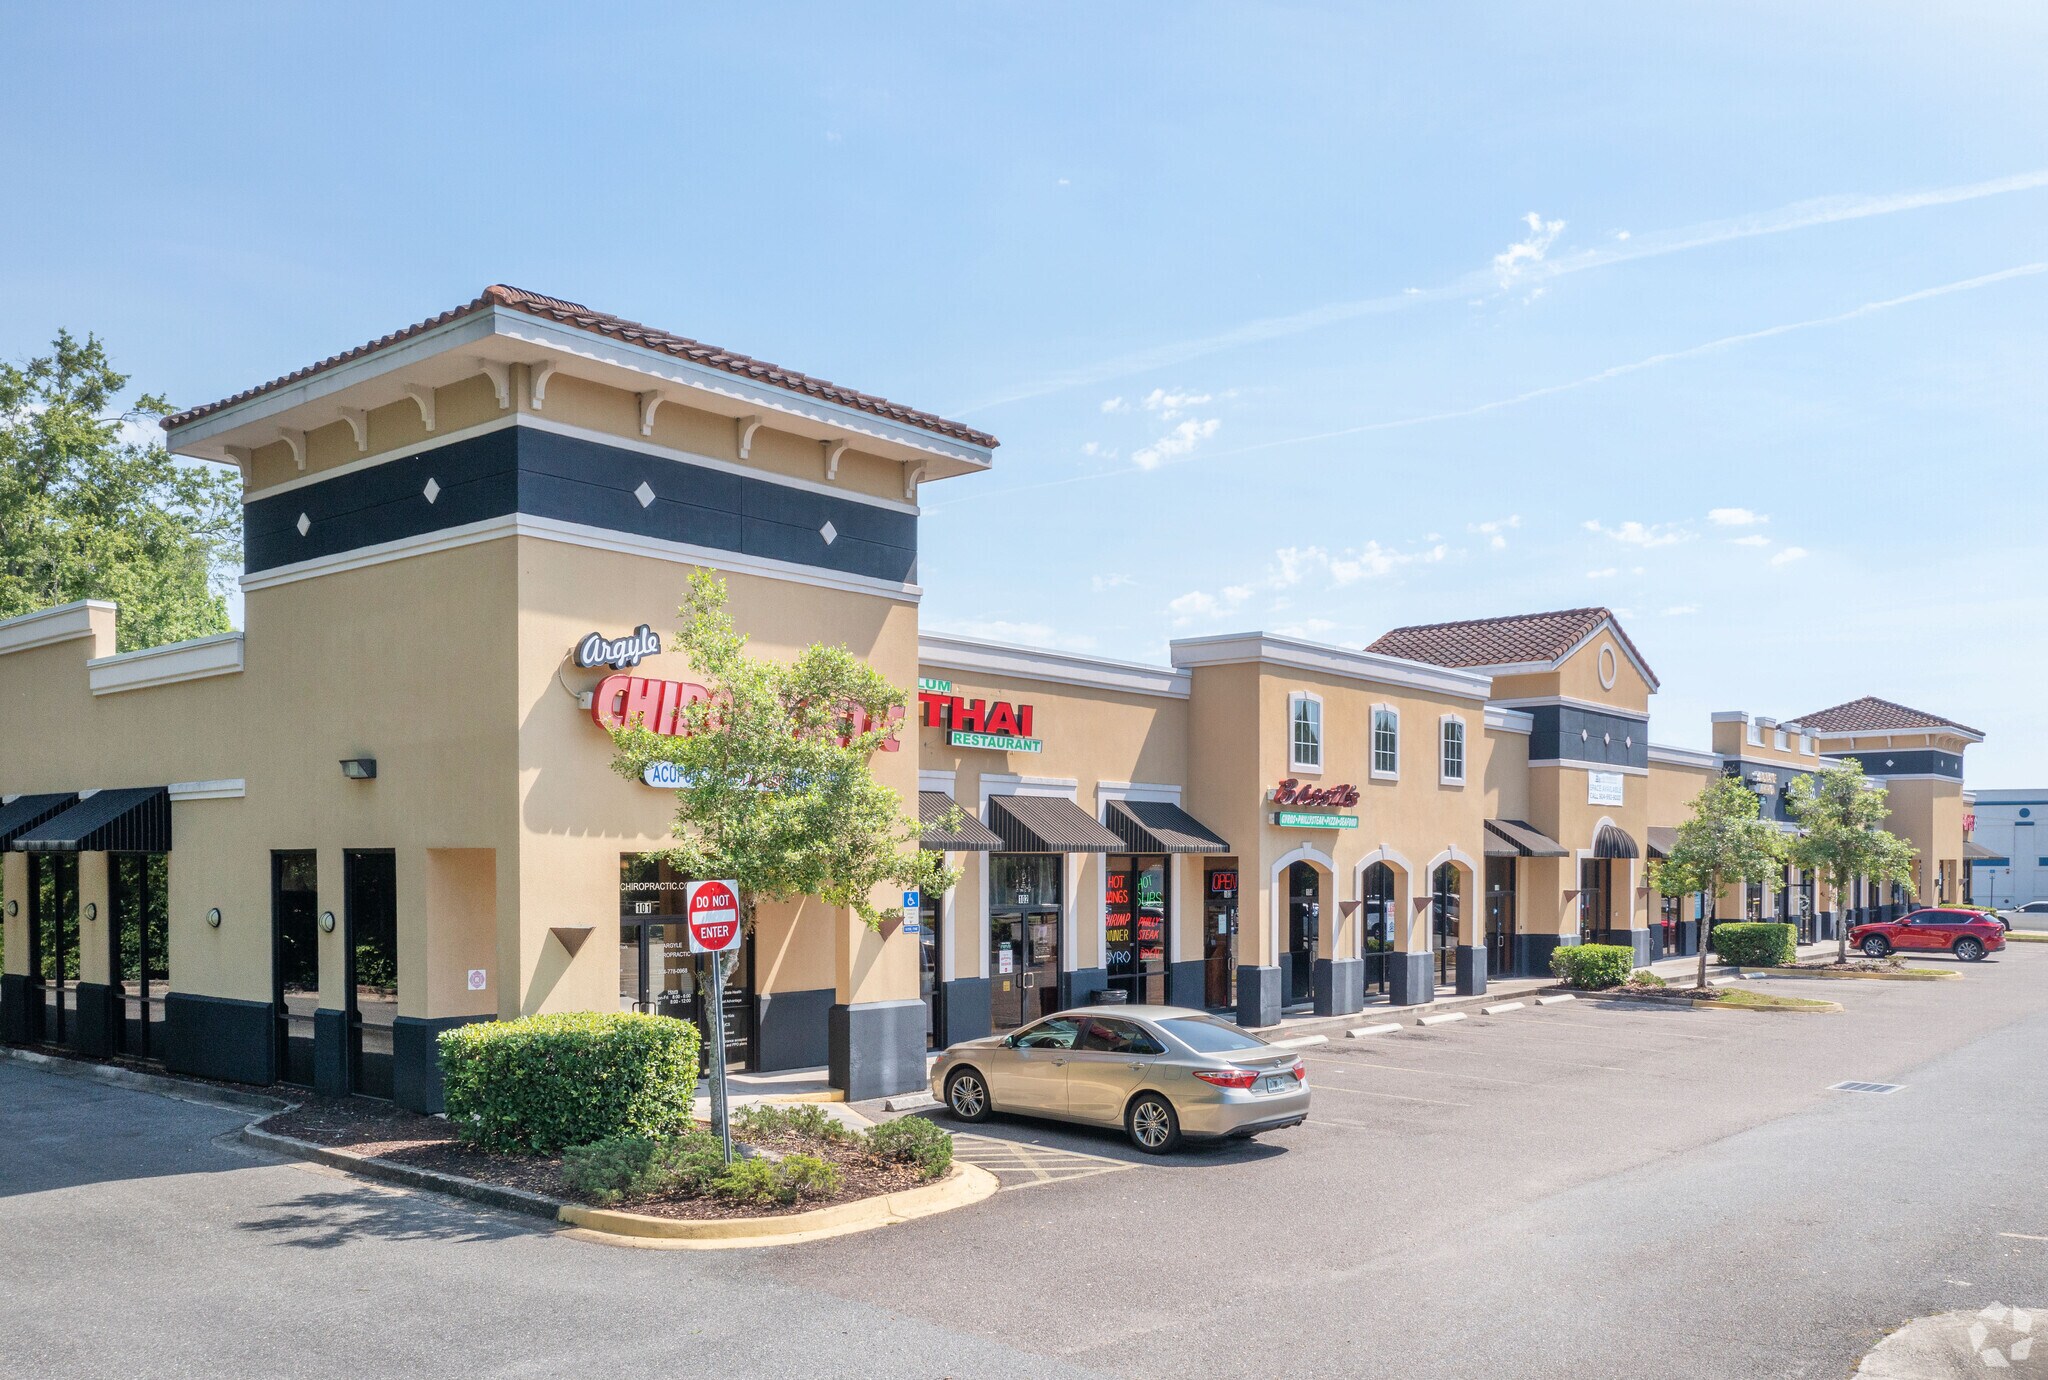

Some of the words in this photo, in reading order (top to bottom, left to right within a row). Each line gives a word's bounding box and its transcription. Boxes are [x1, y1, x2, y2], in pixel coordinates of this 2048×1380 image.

[918, 691, 1034, 737] THAI
[953, 732, 1041, 752] RESTAURANT
[1107, 876, 1125, 888] HOT
[1138, 875, 1152, 891] HOT
[1213, 873, 1238, 890] OPEN
[696, 896, 709, 908] DO
[713, 894, 730, 907] NOT
[636, 903, 652, 914] 101
[1137, 916, 1161, 928] PHILLY
[700, 925, 729, 939] ENTER
[1137, 930, 1160, 940] STEAK
